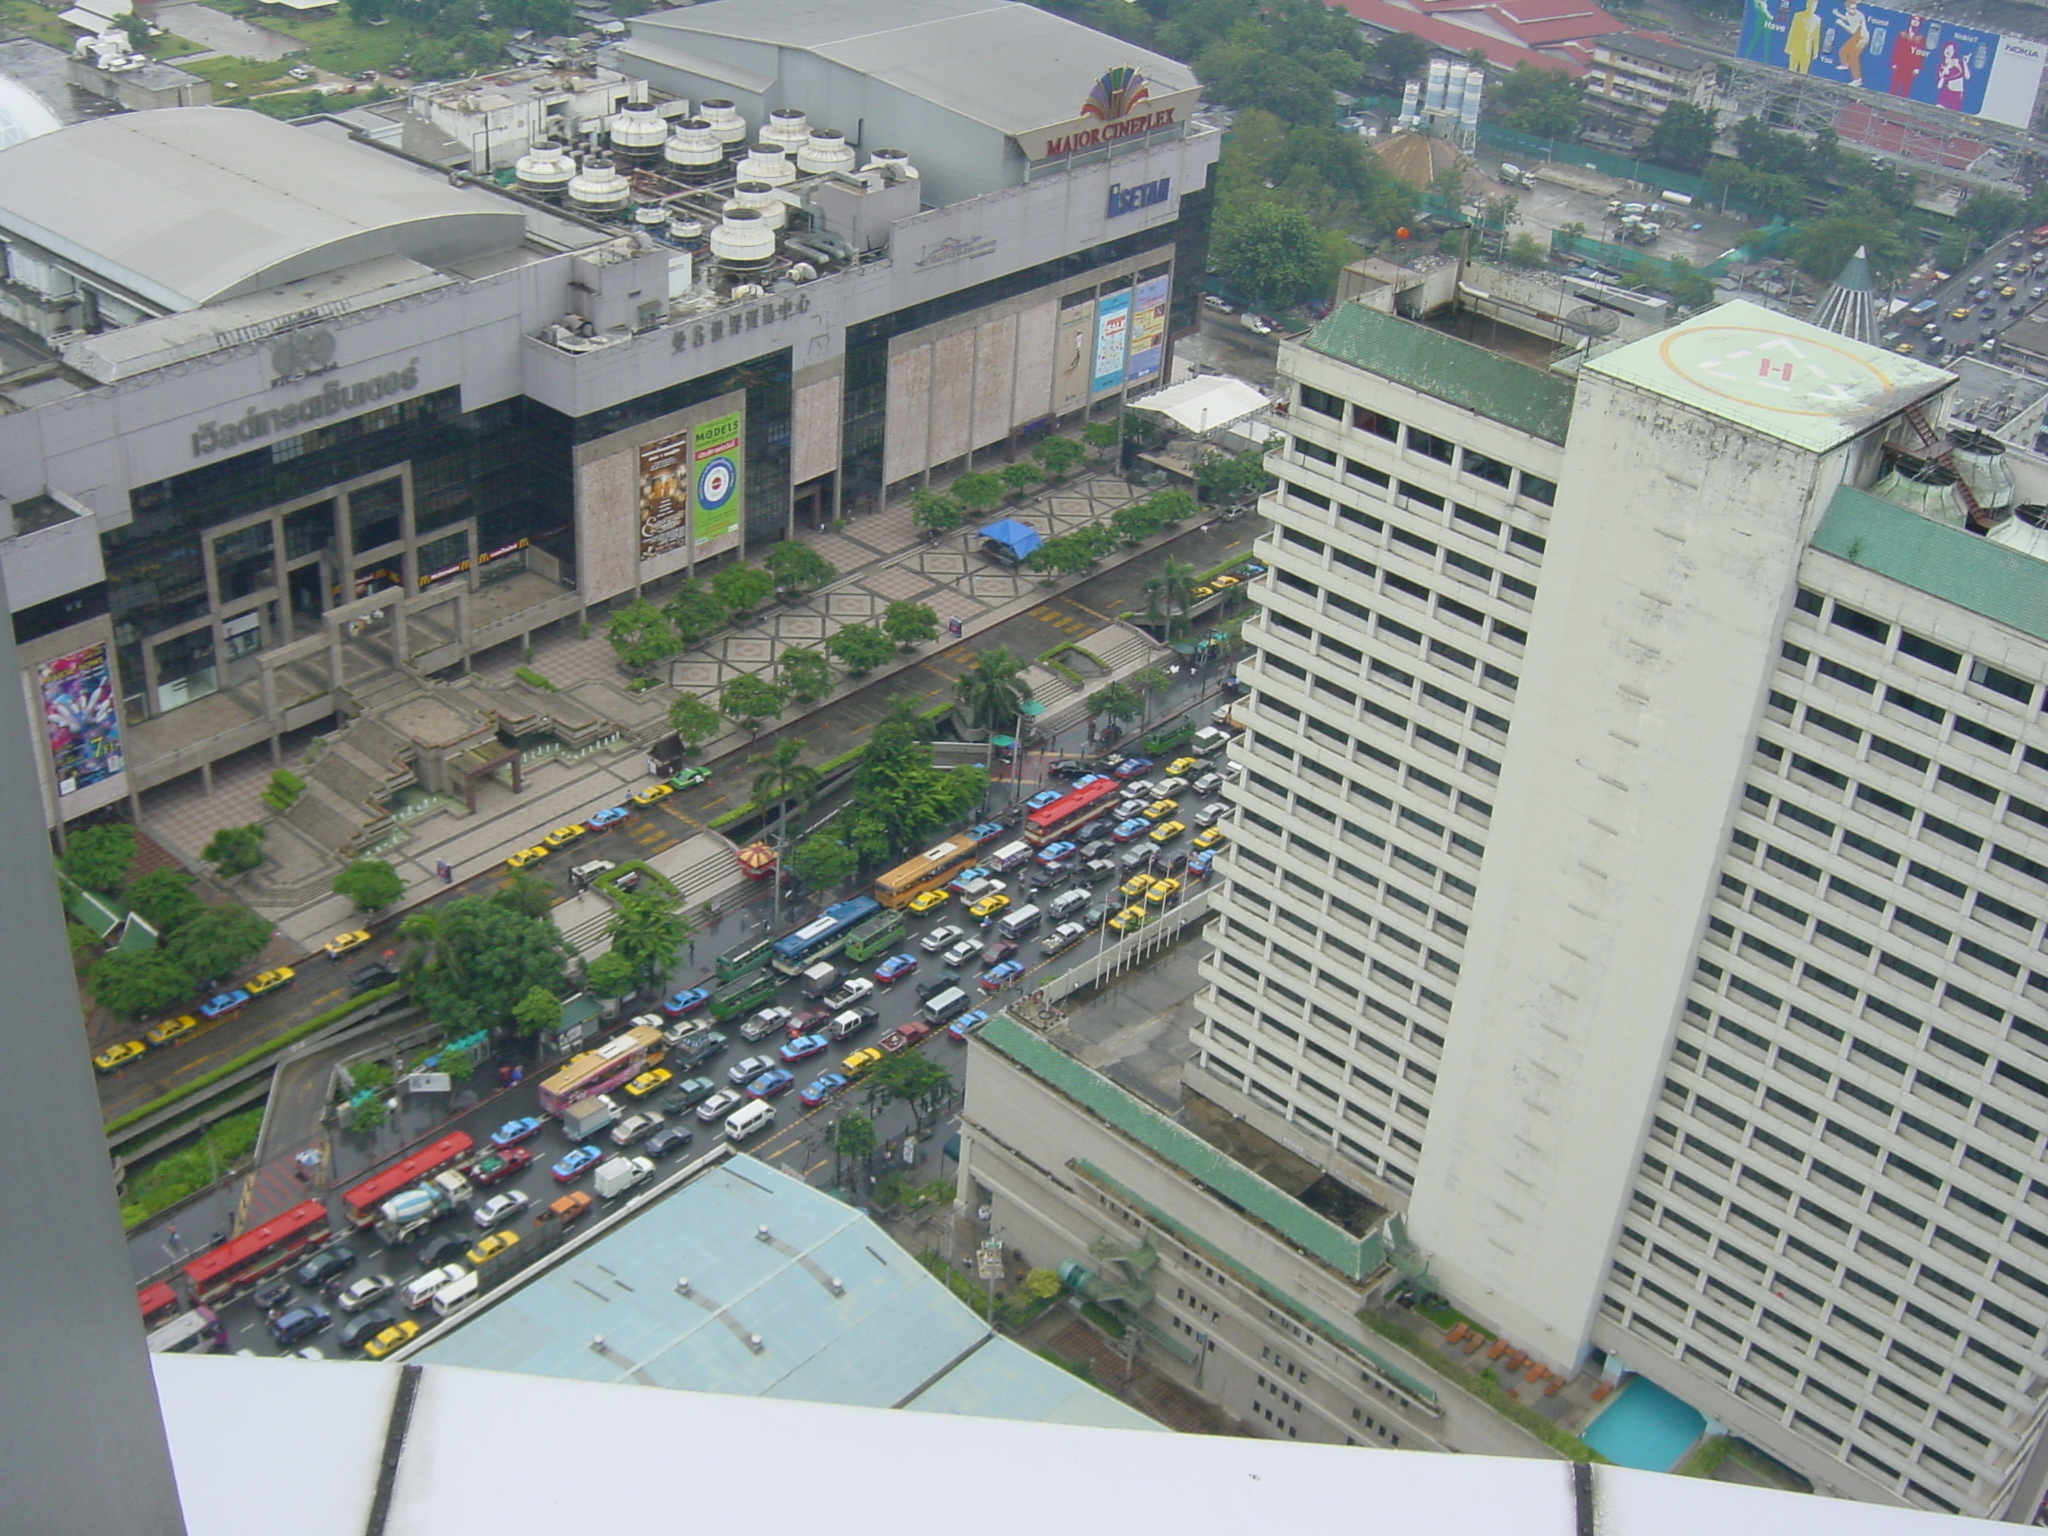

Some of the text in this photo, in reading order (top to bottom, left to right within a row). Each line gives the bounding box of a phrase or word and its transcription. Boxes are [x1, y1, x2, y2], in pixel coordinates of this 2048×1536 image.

[1764, 20, 1786, 33] Have
[1911, 45, 1931, 59] Your
[2006, 43, 2040, 59] NOKIA
[1046, 107, 1176, 156] MAJOR CINEPLEX
[1759, 358, 1793, 382] H
[694, 419, 740, 443] MODELS
